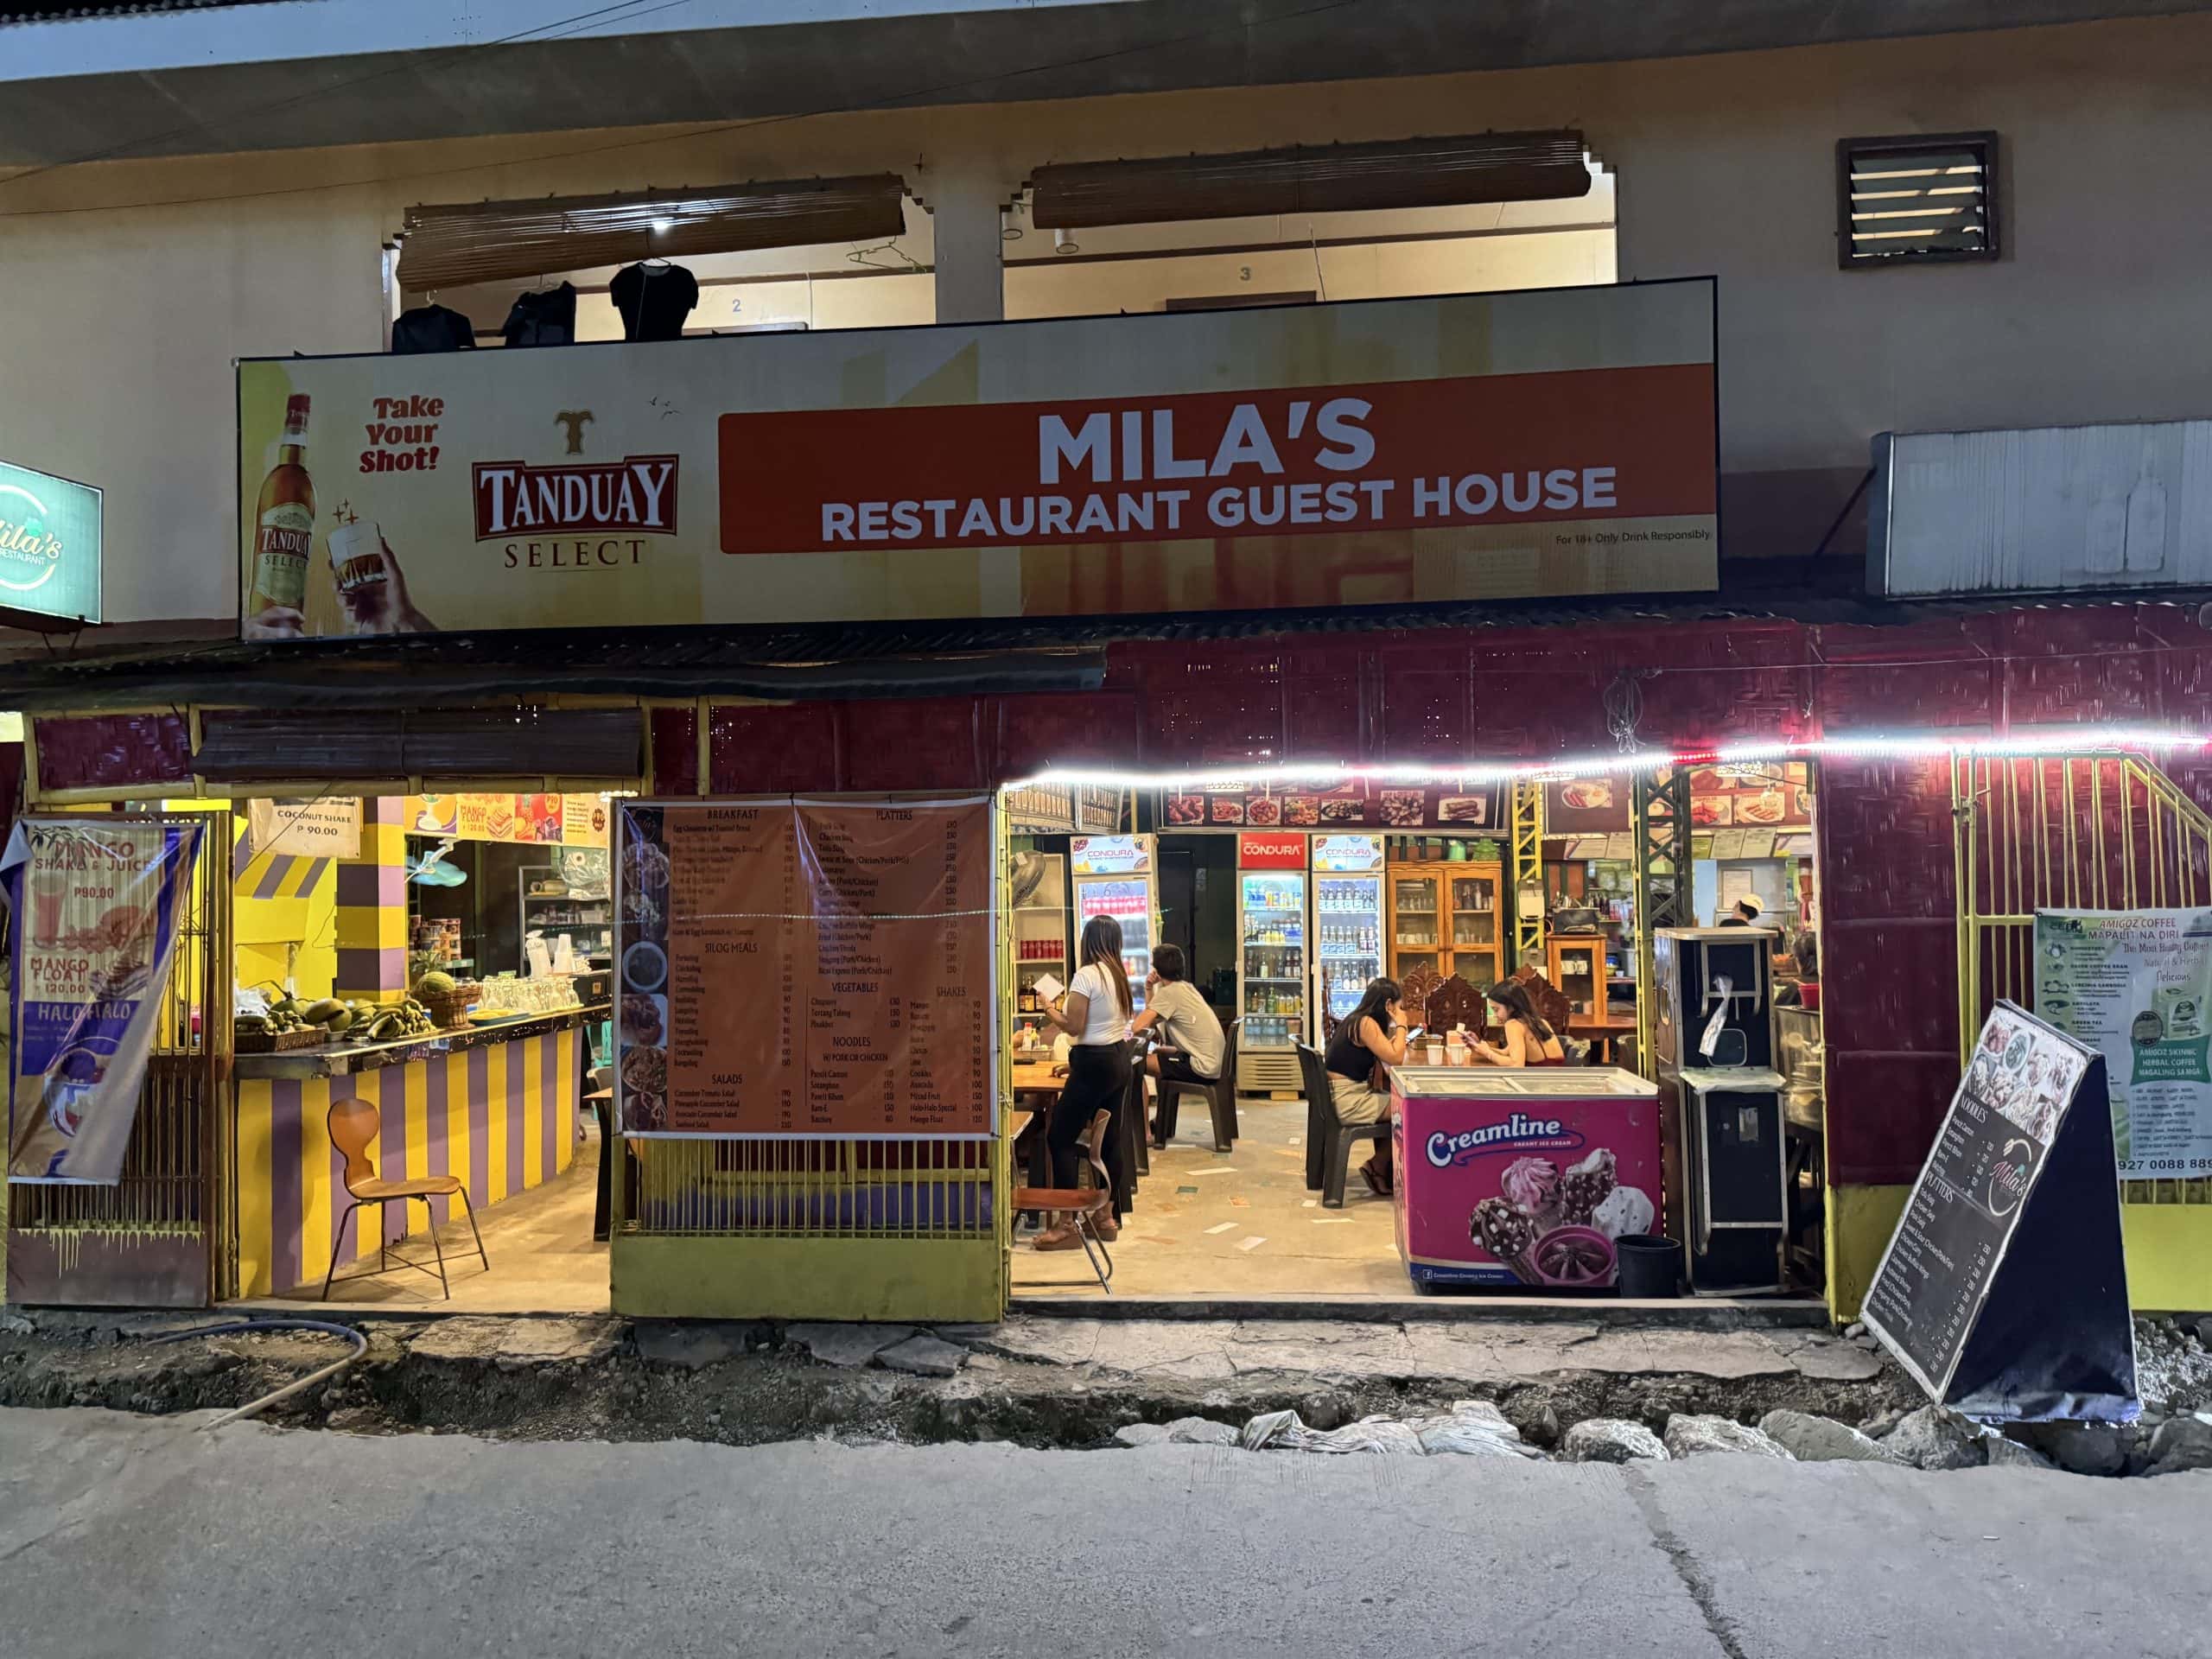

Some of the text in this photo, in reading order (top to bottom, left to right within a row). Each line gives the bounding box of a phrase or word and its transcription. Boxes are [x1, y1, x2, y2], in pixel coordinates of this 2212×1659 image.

[1239, 266, 1251, 282] 3
[733, 299, 741, 312] 2
[373, 395, 444, 421] Take
[365, 423, 439, 446] Your
[1039, 397, 1376, 486] MILA'S
[359, 447, 441, 476] Shot!
[480, 463, 673, 532] TANDUAY
[822, 467, 1618, 542] RESTAURANT GUEST HOUSE
[1556, 536, 1571, 545] For
[1595, 533, 1618, 545] Only
[1622, 531, 1649, 543] Drink
[1651, 529, 1709, 542] Responsibly
[505, 538, 646, 569] SELECT
[277, 810, 353, 823] COCONUT SHAKE
[708, 809, 760, 821] BREAKFAST
[876, 810, 912, 822] PLATTERS
[307, 826, 339, 836] 90.00
[1243, 845, 1300, 856] CONDURA
[2100, 918, 2177, 929] AMIGOZ COFFEE
[2140, 931, 2157, 939] NA
[2158, 931, 2179, 939] DIRI
[732, 943, 758, 954] MEALS
[31, 957, 89, 973] MANGO
[34, 969, 85, 982] FLOAT
[832, 982, 879, 993] VEGETABLES
[936, 987, 967, 997] SHAKES
[832, 1036, 871, 1047] NOODLES
[860, 1053, 888, 1062] CHICKEN
[712, 1073, 742, 1085] SALADS
[1427, 1113, 1560, 1167] Creamline
[2150, 1160, 2185, 1170] 0088
[1989, 1160, 2027, 1197] Mila's
